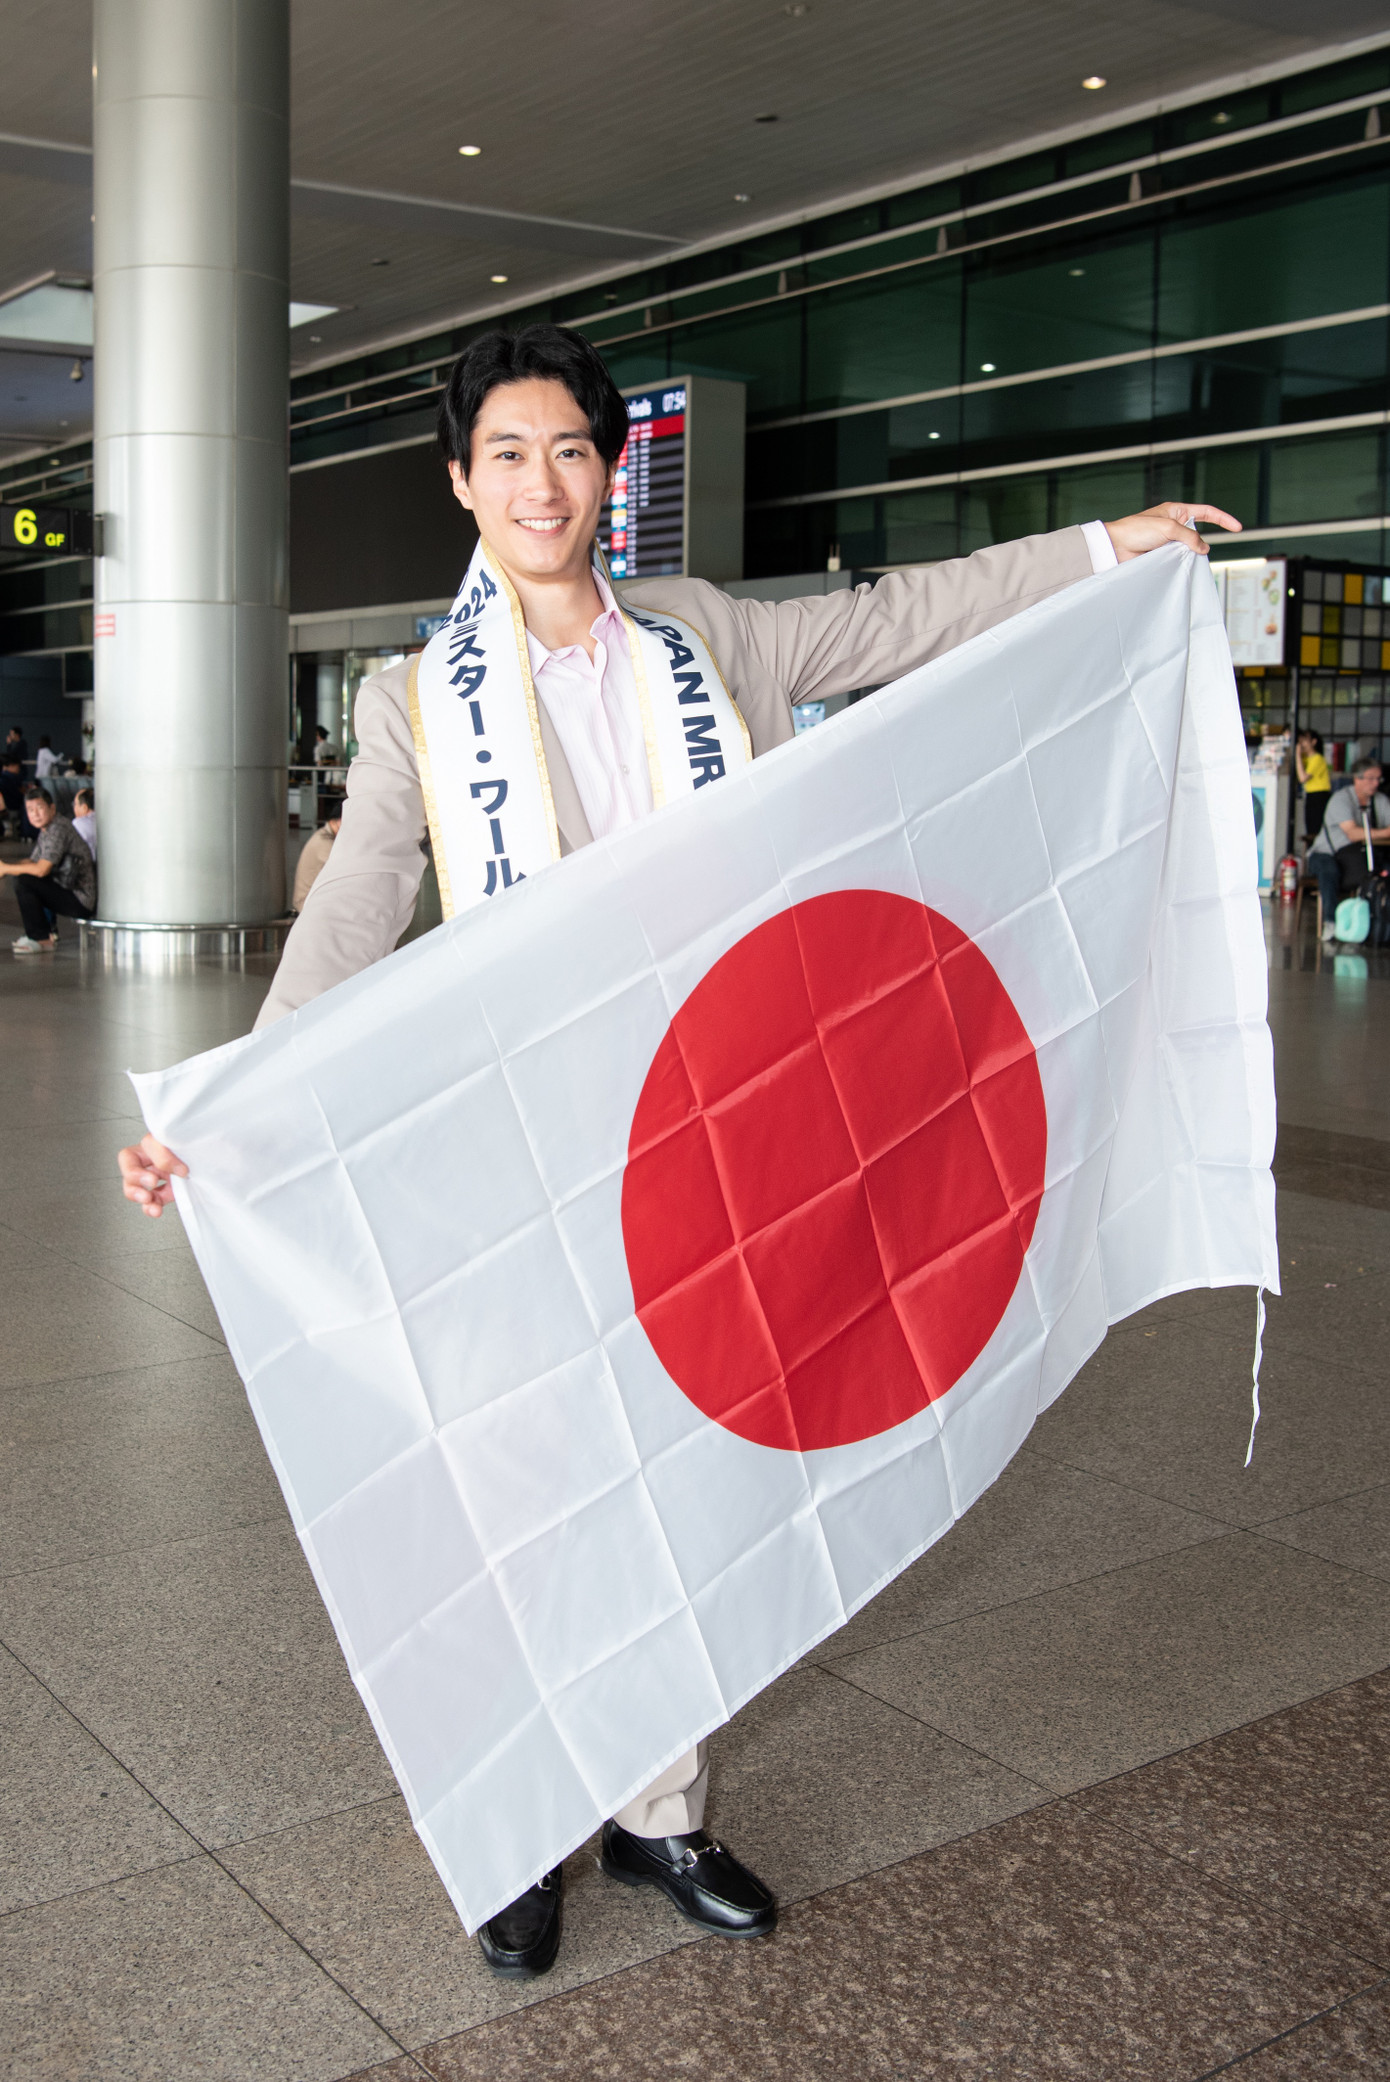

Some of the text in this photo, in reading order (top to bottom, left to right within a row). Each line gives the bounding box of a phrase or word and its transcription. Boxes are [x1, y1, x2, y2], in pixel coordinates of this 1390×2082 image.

[14, 508, 66, 547] 6 GF
[436, 568, 498, 633] 2024
[682, 714, 726, 790] MR
